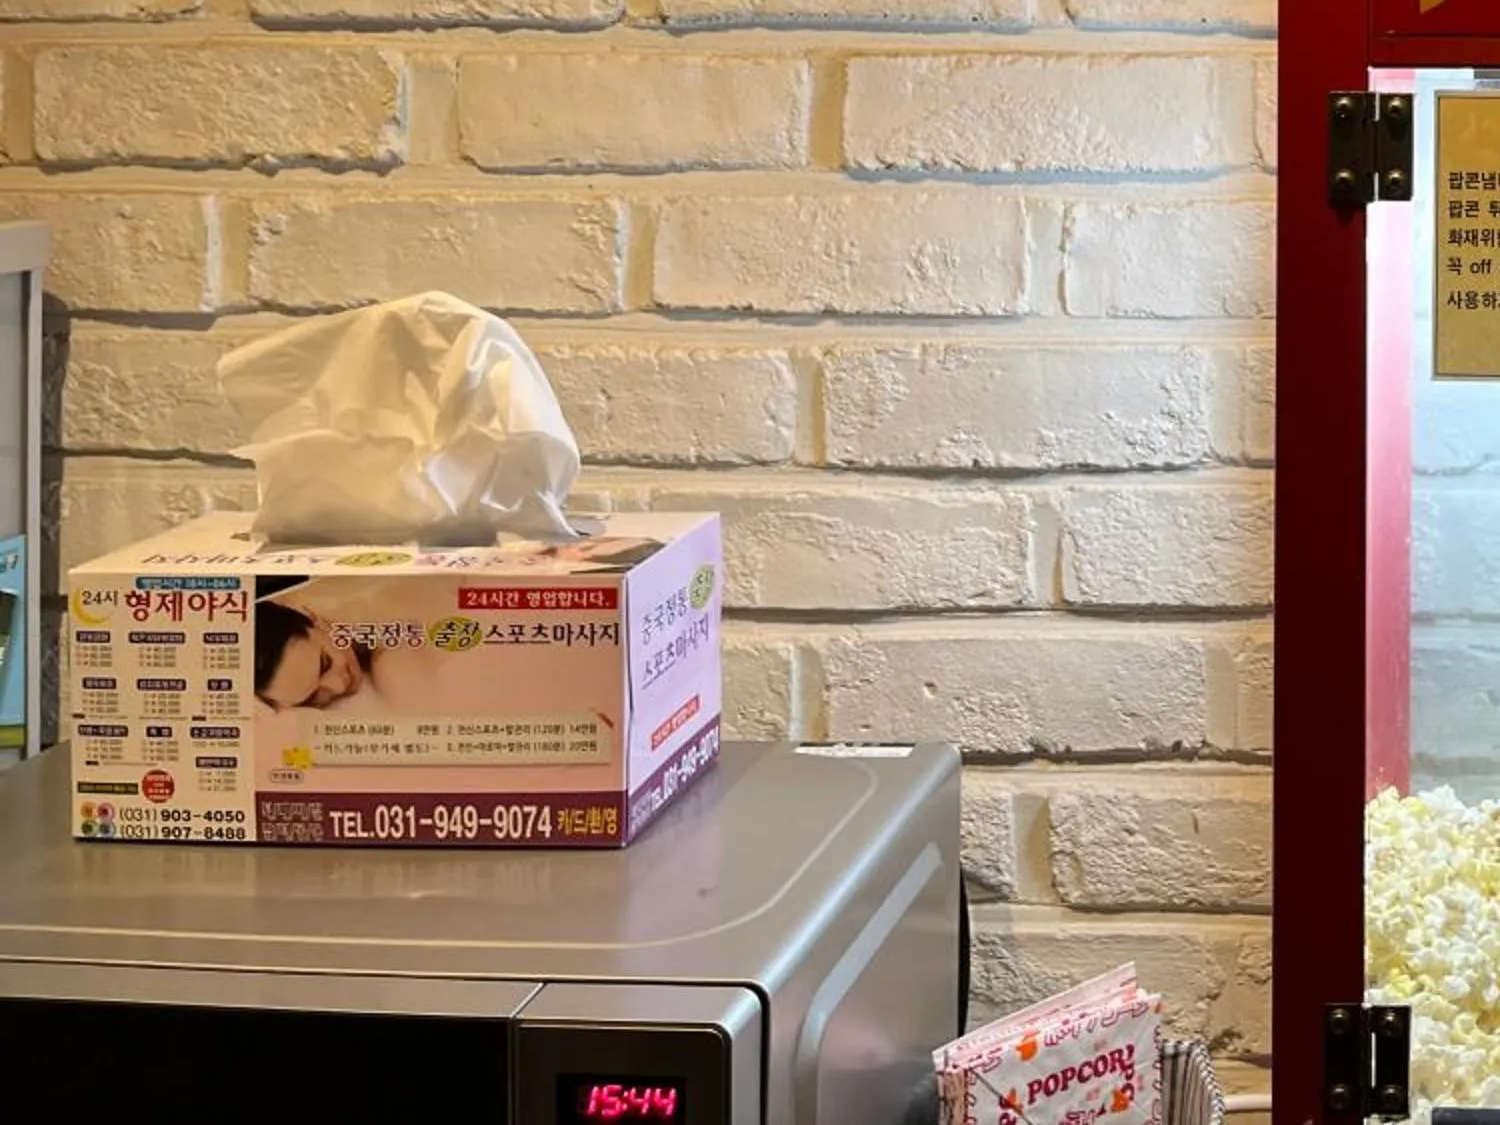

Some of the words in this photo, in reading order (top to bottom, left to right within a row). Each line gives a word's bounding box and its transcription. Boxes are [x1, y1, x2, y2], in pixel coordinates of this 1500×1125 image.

[1447, 199, 1480, 220] 팝콘
[1469, 258, 1493, 275] off
[81, 589, 119, 607] 24시
[124, 590, 249, 623] 형제야식
[465, 590, 520, 608] 24시간
[331, 622, 427, 650] 중국정통
[484, 621, 620, 648] 스포츠마사지
[119, 807, 158, 823] (031)
[160, 809, 246, 824] 903-4050
[119, 824, 159, 839] (031)
[586, 1084, 678, 1117] 15:44
